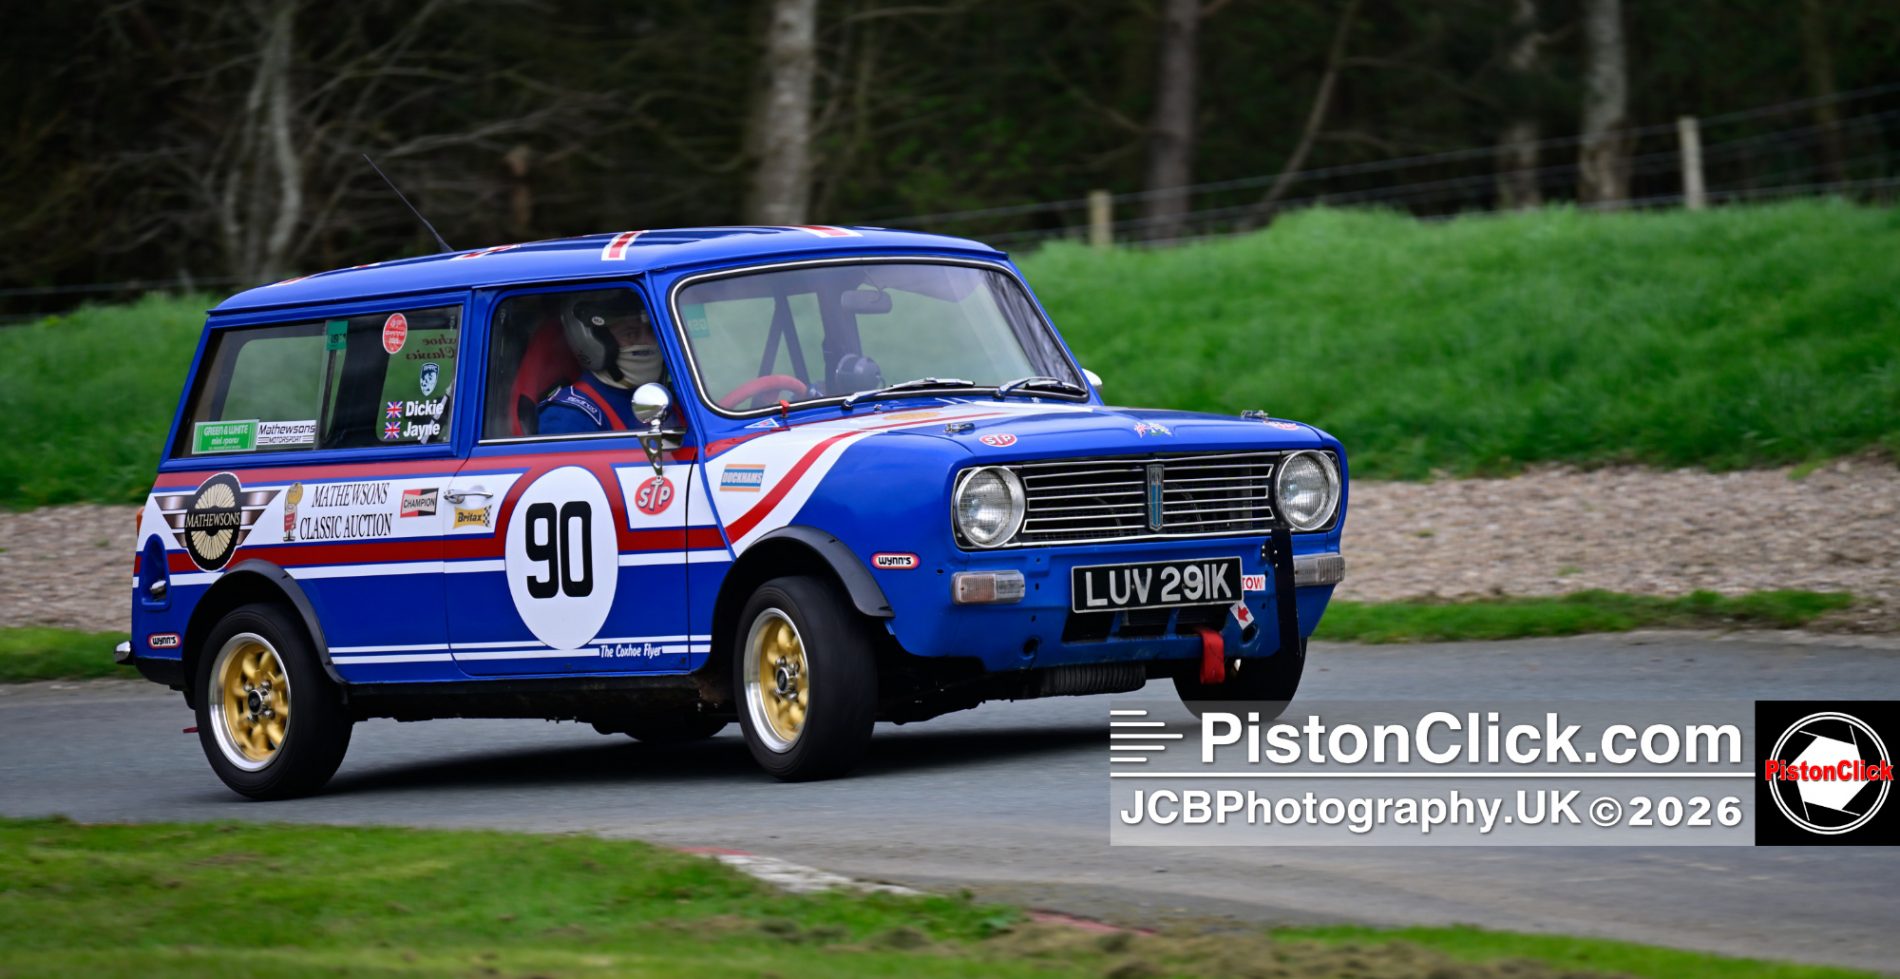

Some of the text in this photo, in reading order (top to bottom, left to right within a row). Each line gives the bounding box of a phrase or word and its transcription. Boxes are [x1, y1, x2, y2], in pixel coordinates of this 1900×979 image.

[405, 400, 444, 416] Dickie
[258, 423, 315, 436] Mathewsons
[403, 421, 440, 440] Jayne
[984, 434, 1012, 446] STP
[721, 471, 762, 484] DUCKHAMS
[311, 482, 390, 508] MATHEWSONS
[403, 497, 435, 509] CHAMPION
[637, 480, 671, 512] STP
[185, 511, 241, 528] MATHEWSONS
[457, 511, 482, 523] Britax
[300, 513, 392, 540] CLASSIC AUCTION
[525, 501, 593, 599] 90
[1085, 563, 1232, 607] LUV 291K
[1242, 575, 1263, 590] TOW
[600, 642, 662, 660] The Coxhoe Flyer
